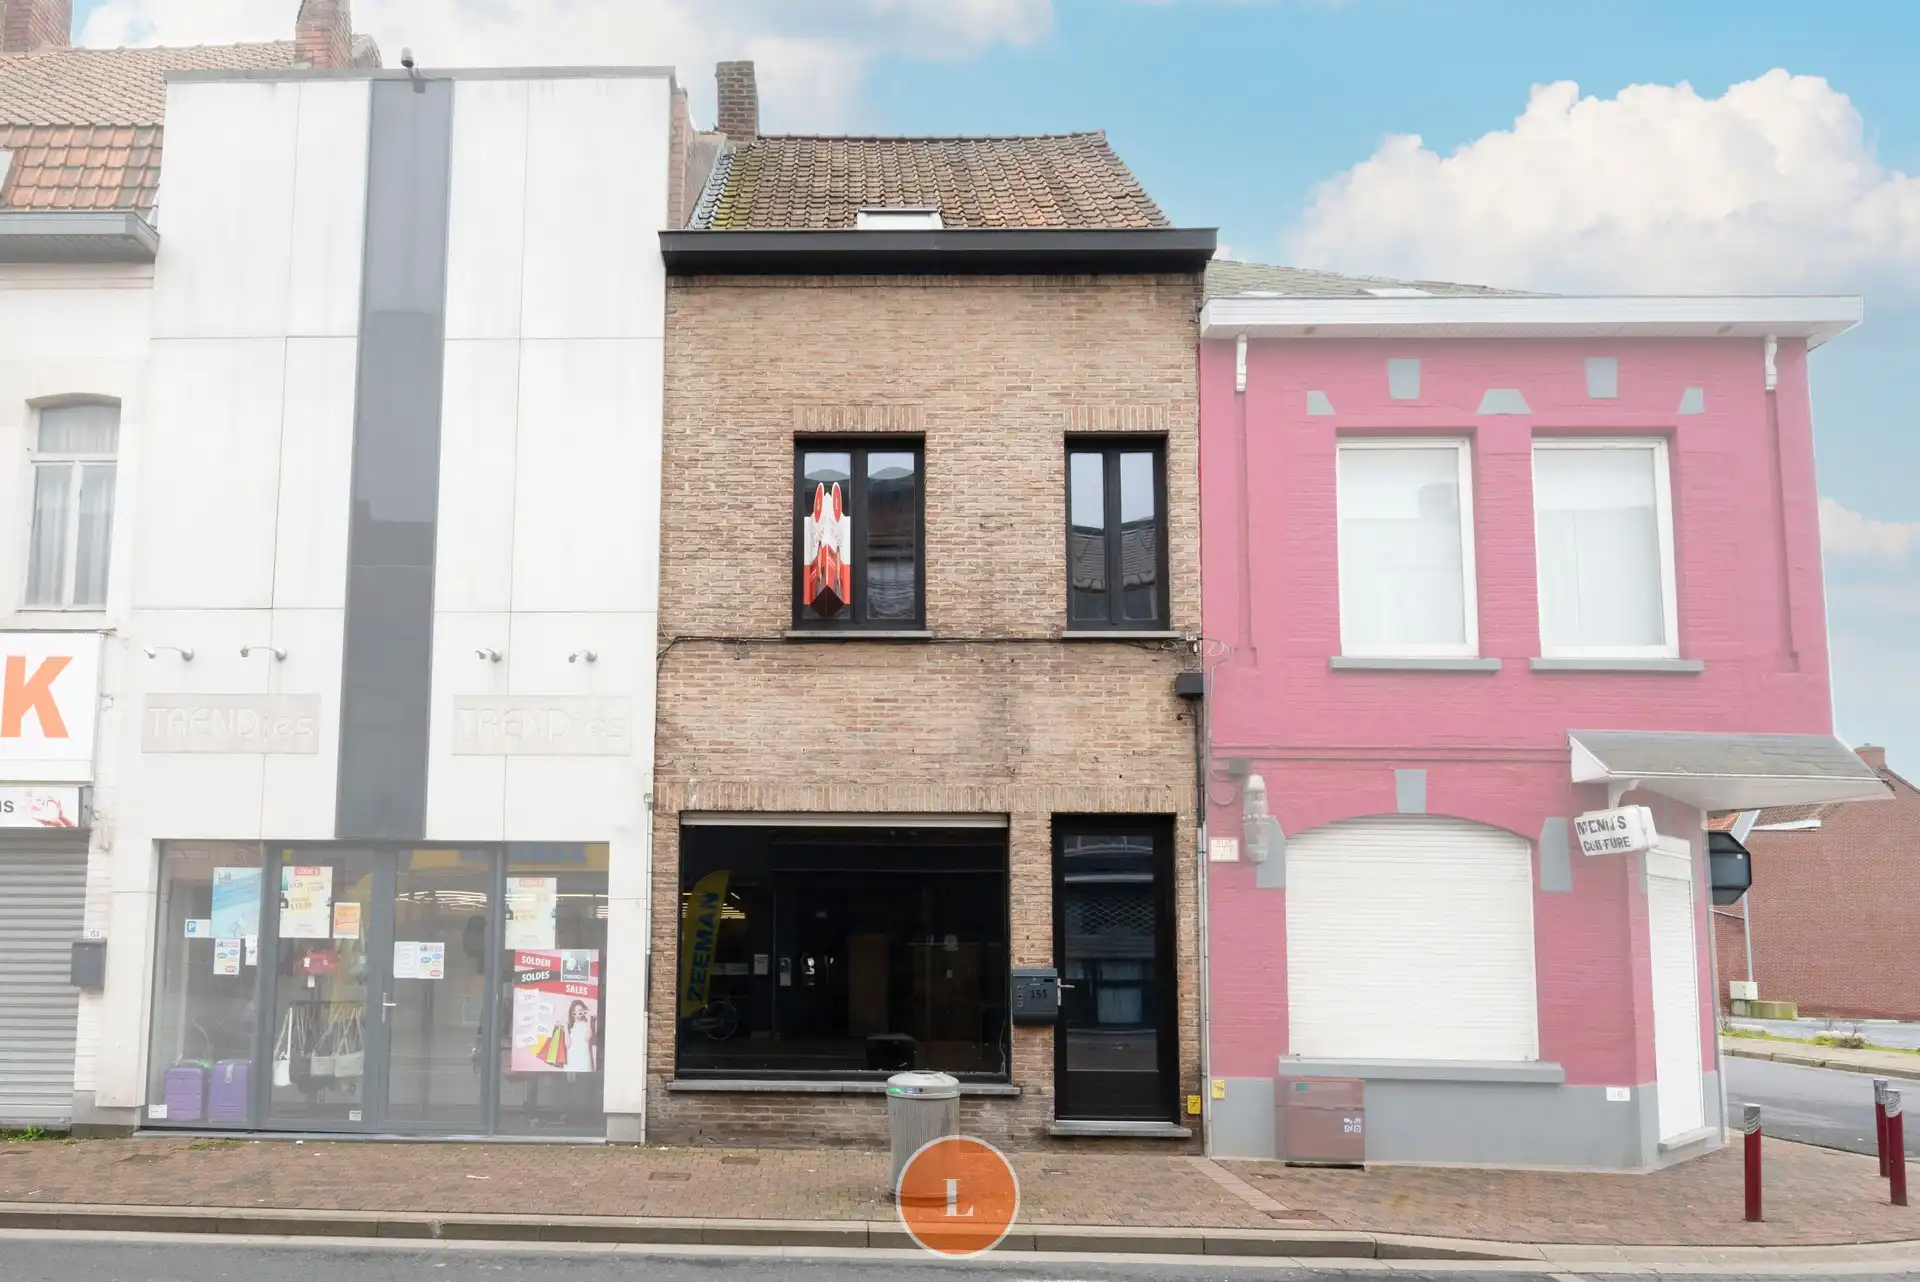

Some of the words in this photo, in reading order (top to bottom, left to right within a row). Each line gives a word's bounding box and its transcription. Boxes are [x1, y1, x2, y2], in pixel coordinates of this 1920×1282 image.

[0, 655, 73, 739] K
[686, 891, 719, 1001] ZEEMAN
[521, 955, 551, 968] SOLDEN
[521, 970, 550, 982] SOLDES
[565, 984, 589, 995] SALES
[1031, 988, 1048, 999] 155
